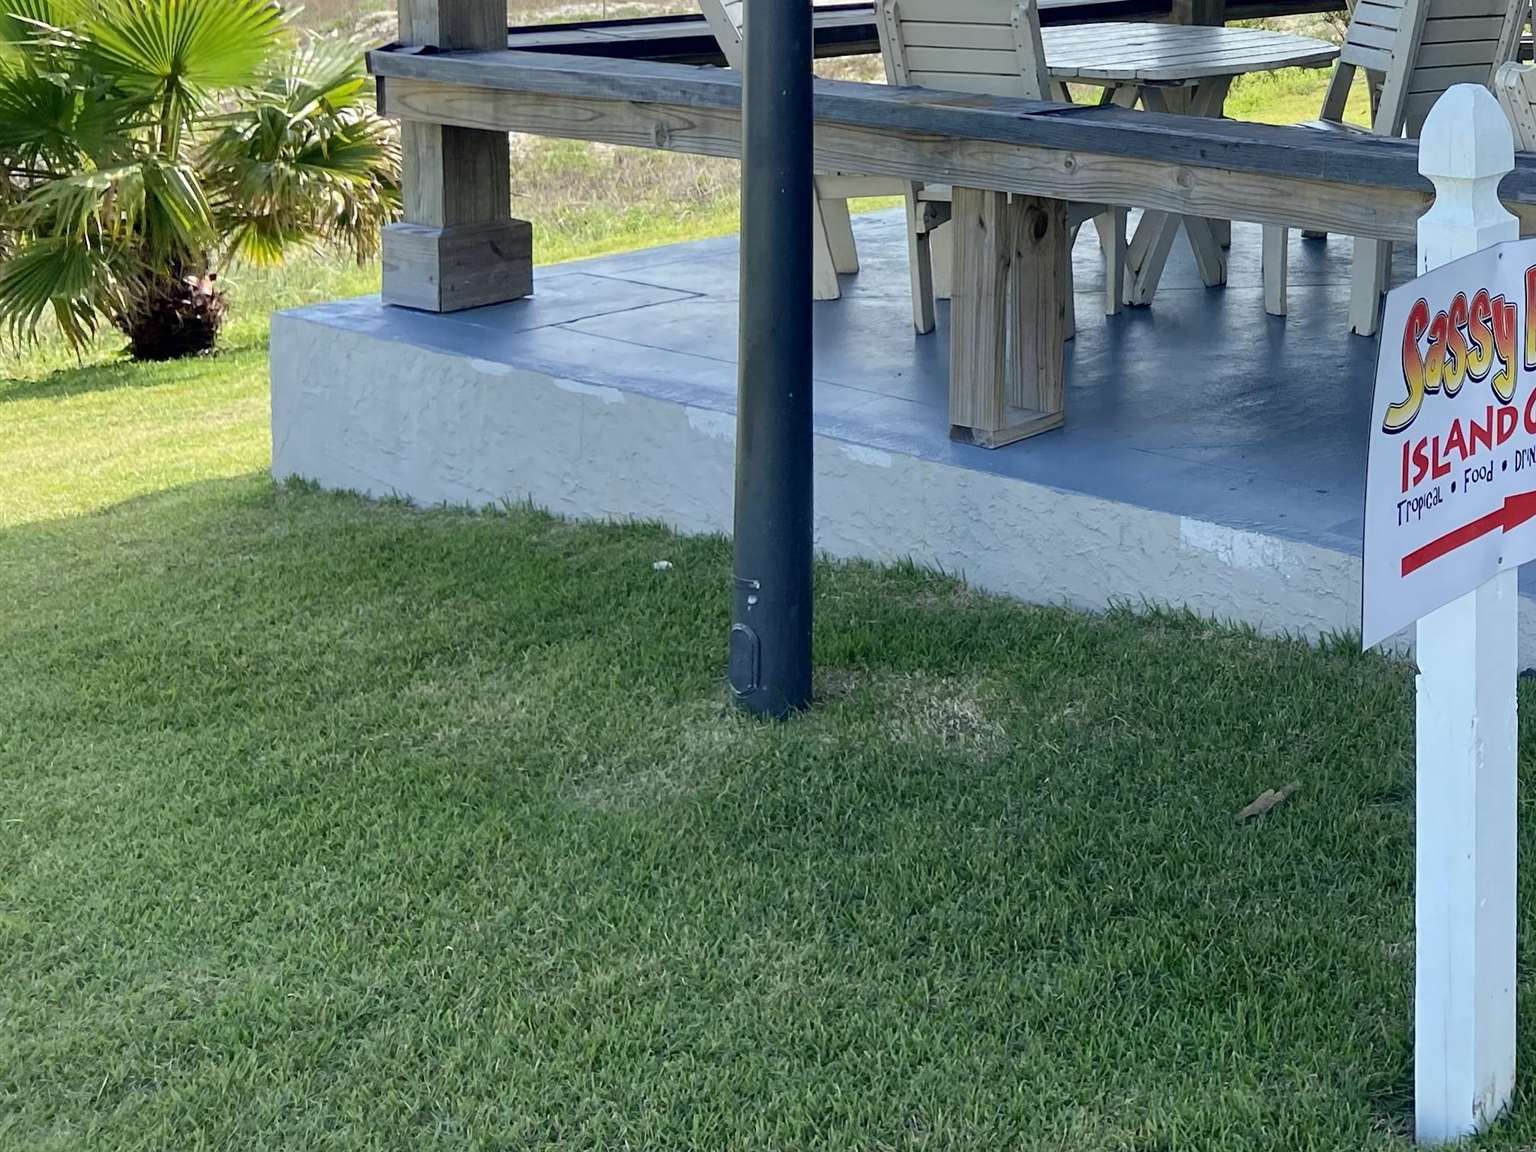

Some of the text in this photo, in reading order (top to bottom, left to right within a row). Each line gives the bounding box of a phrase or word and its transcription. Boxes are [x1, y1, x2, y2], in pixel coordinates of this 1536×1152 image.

[1382, 288, 1518, 435] Sassy
[1396, 485, 1443, 527] Tropical
[1464, 459, 1494, 493] Food
[1401, 405, 1518, 493] ISLAND
